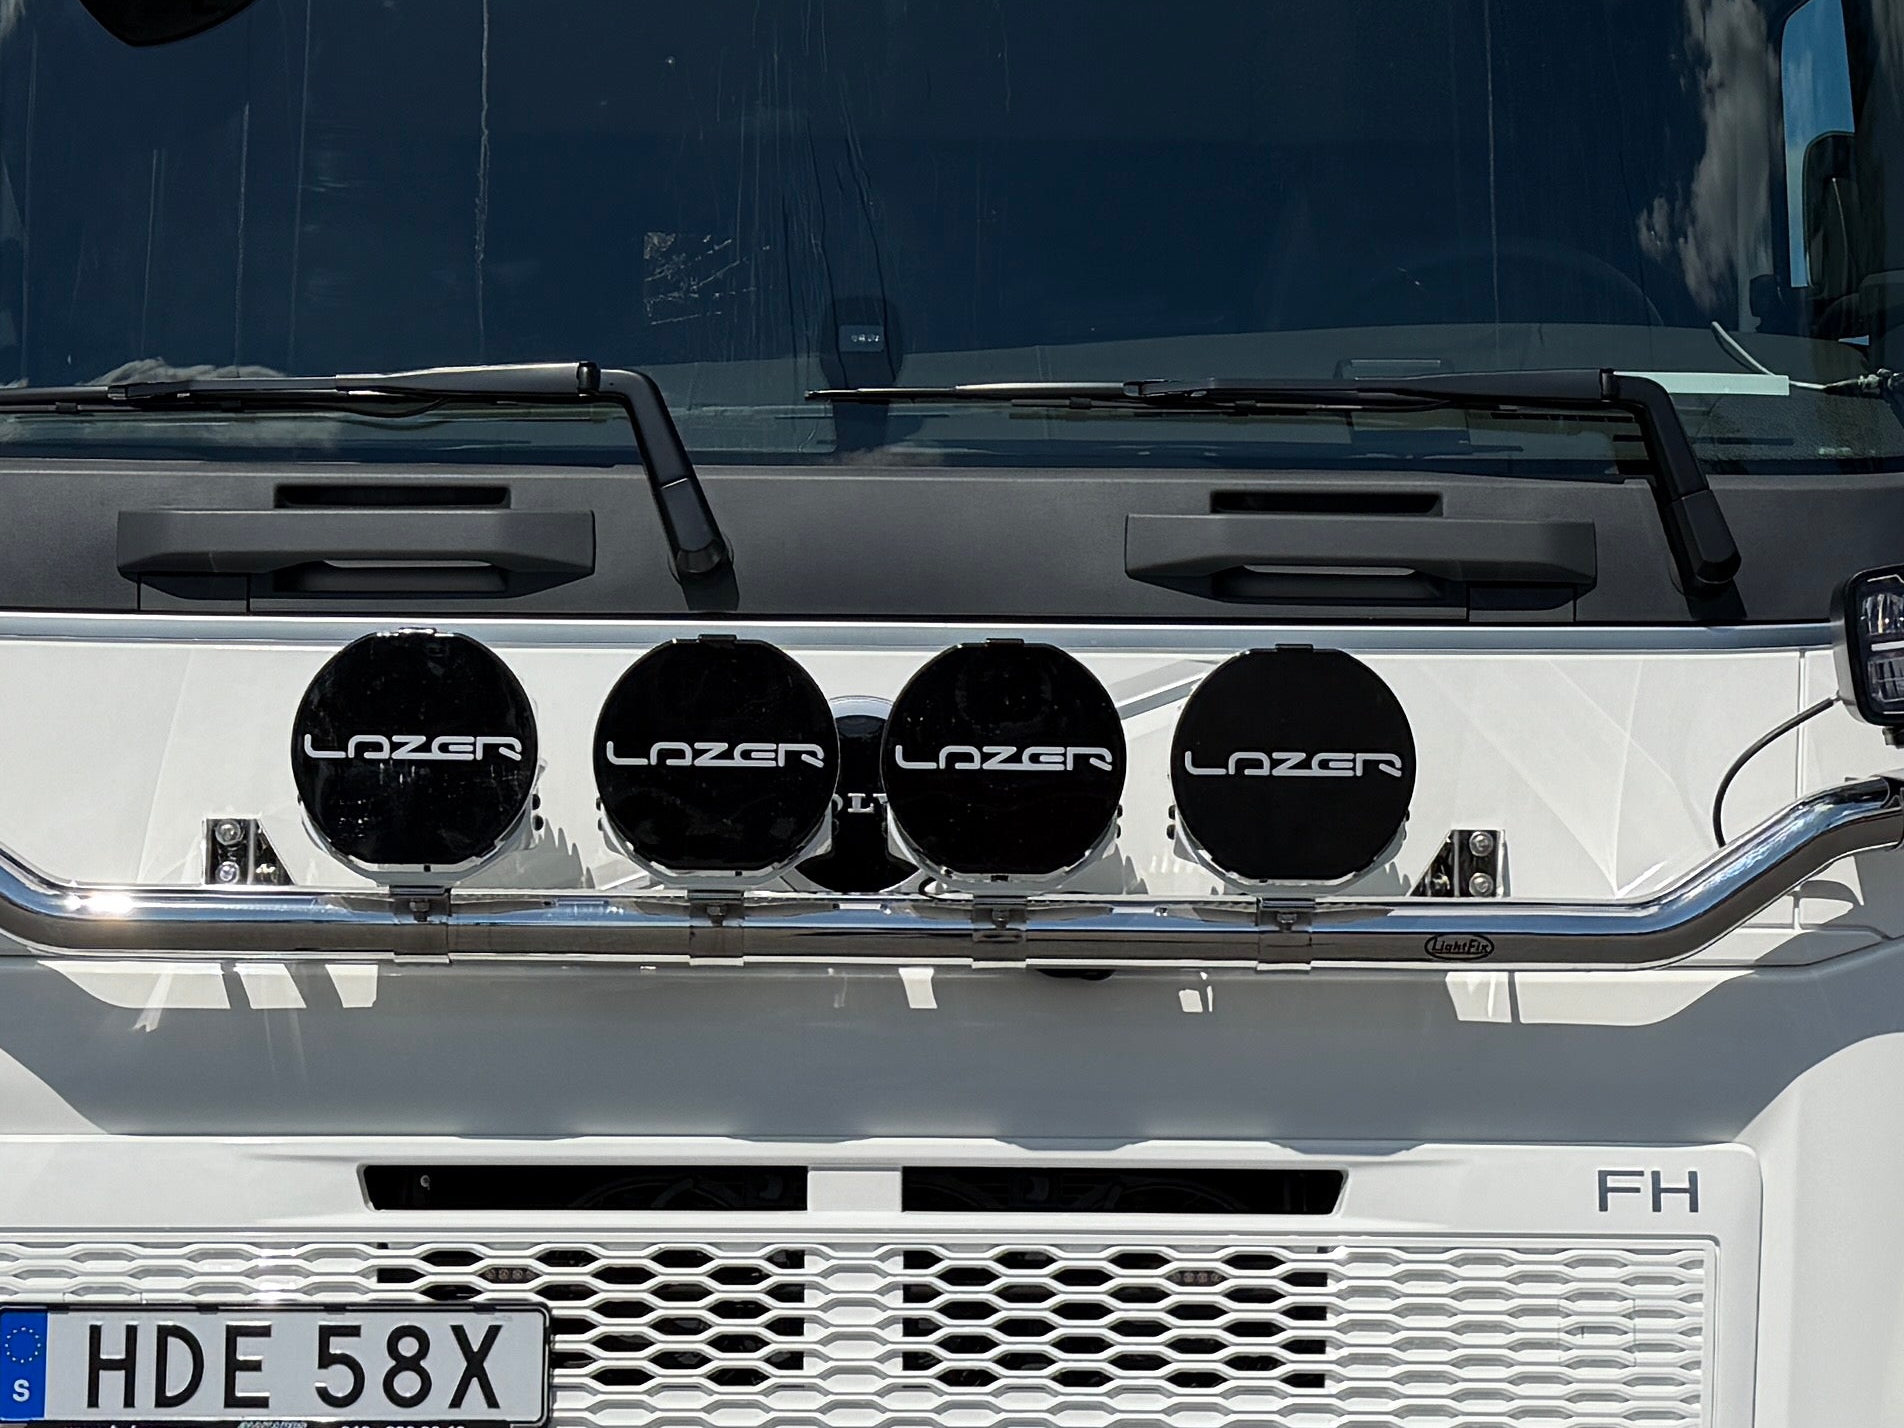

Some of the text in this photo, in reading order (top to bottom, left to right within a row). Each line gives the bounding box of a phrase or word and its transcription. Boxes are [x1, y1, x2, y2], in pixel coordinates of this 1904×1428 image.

[303, 733, 522, 762] LAZER
[606, 740, 825, 768] LAZER
[895, 744, 1113, 772] LAZER
[1184, 750, 1402, 778] LAZER
[1597, 1170, 1699, 1213] FH
[86, 1324, 504, 1410] HDE 58X
[11, 1378, 31, 1404] S
